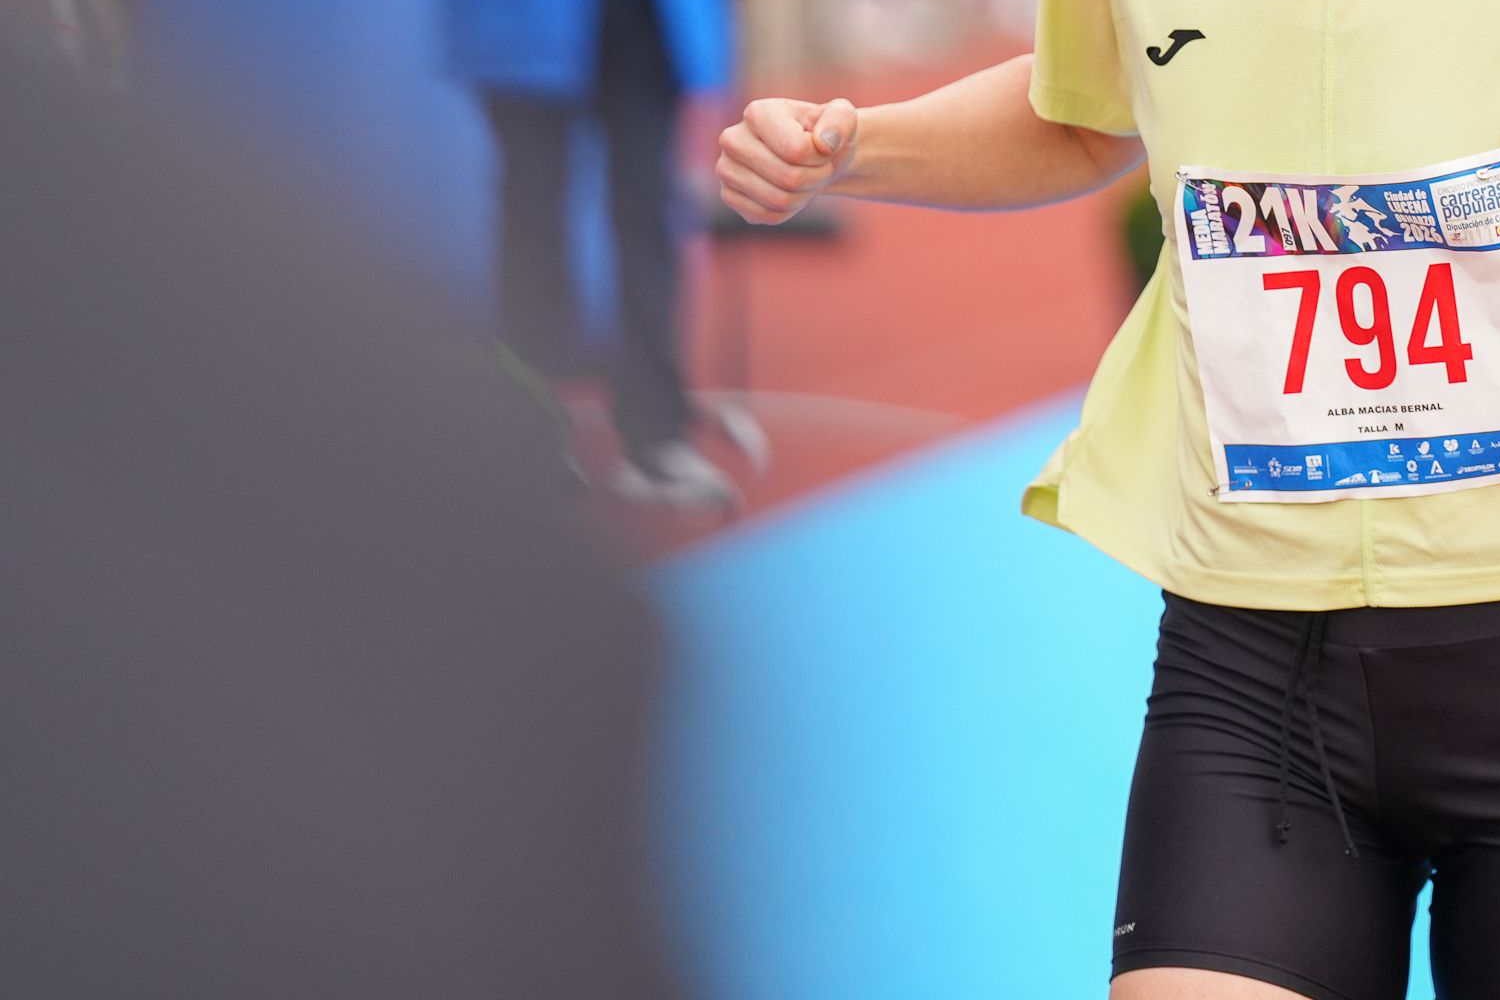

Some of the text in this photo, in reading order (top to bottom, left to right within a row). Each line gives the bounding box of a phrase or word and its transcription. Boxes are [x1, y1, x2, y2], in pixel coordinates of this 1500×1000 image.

[1383, 188, 1427, 202] Ciudad de
[1386, 200, 1431, 214] LUCENA
[1222, 185, 1339, 253] 21K
[1446, 219, 1484, 231] Diputación
[1485, 216, 1494, 225] de
[1190, 209, 1213, 255] MEDIA
[1400, 222, 1444, 244] 2026
[1263, 263, 1473, 394] 794
[1327, 403, 1443, 417] ALBA MACIAS BERNAL
[1358, 422, 1404, 434] TALLA M
